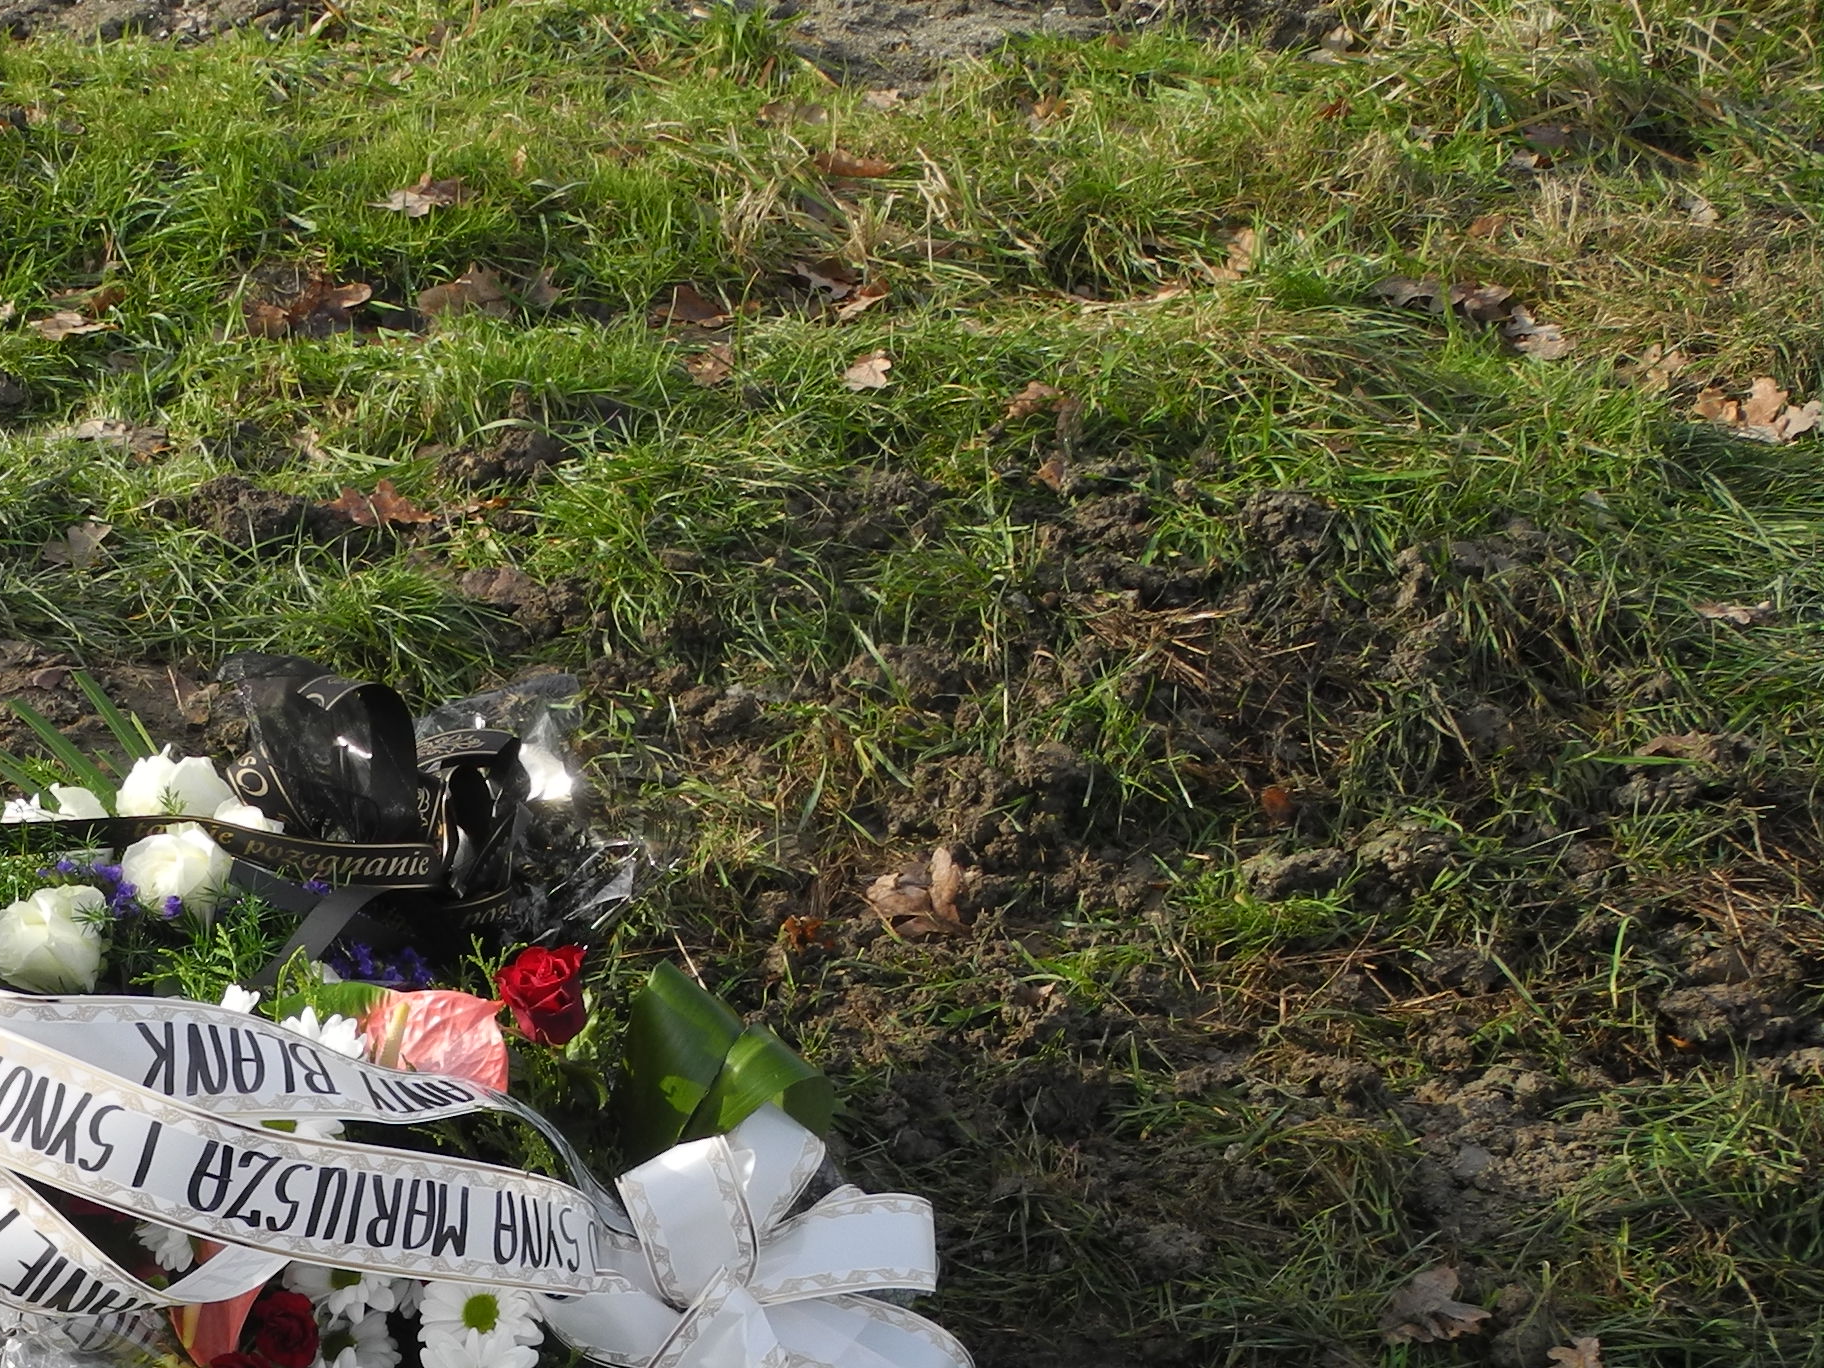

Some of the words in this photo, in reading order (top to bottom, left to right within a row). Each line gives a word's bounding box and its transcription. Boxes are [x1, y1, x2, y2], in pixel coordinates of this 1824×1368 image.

[134, 1022, 340, 1097] BLANK
[132, 1122, 162, 1189] I
[186, 1141, 470, 1257] MARIUSZA
[493, 1189, 581, 1274] SYNA
